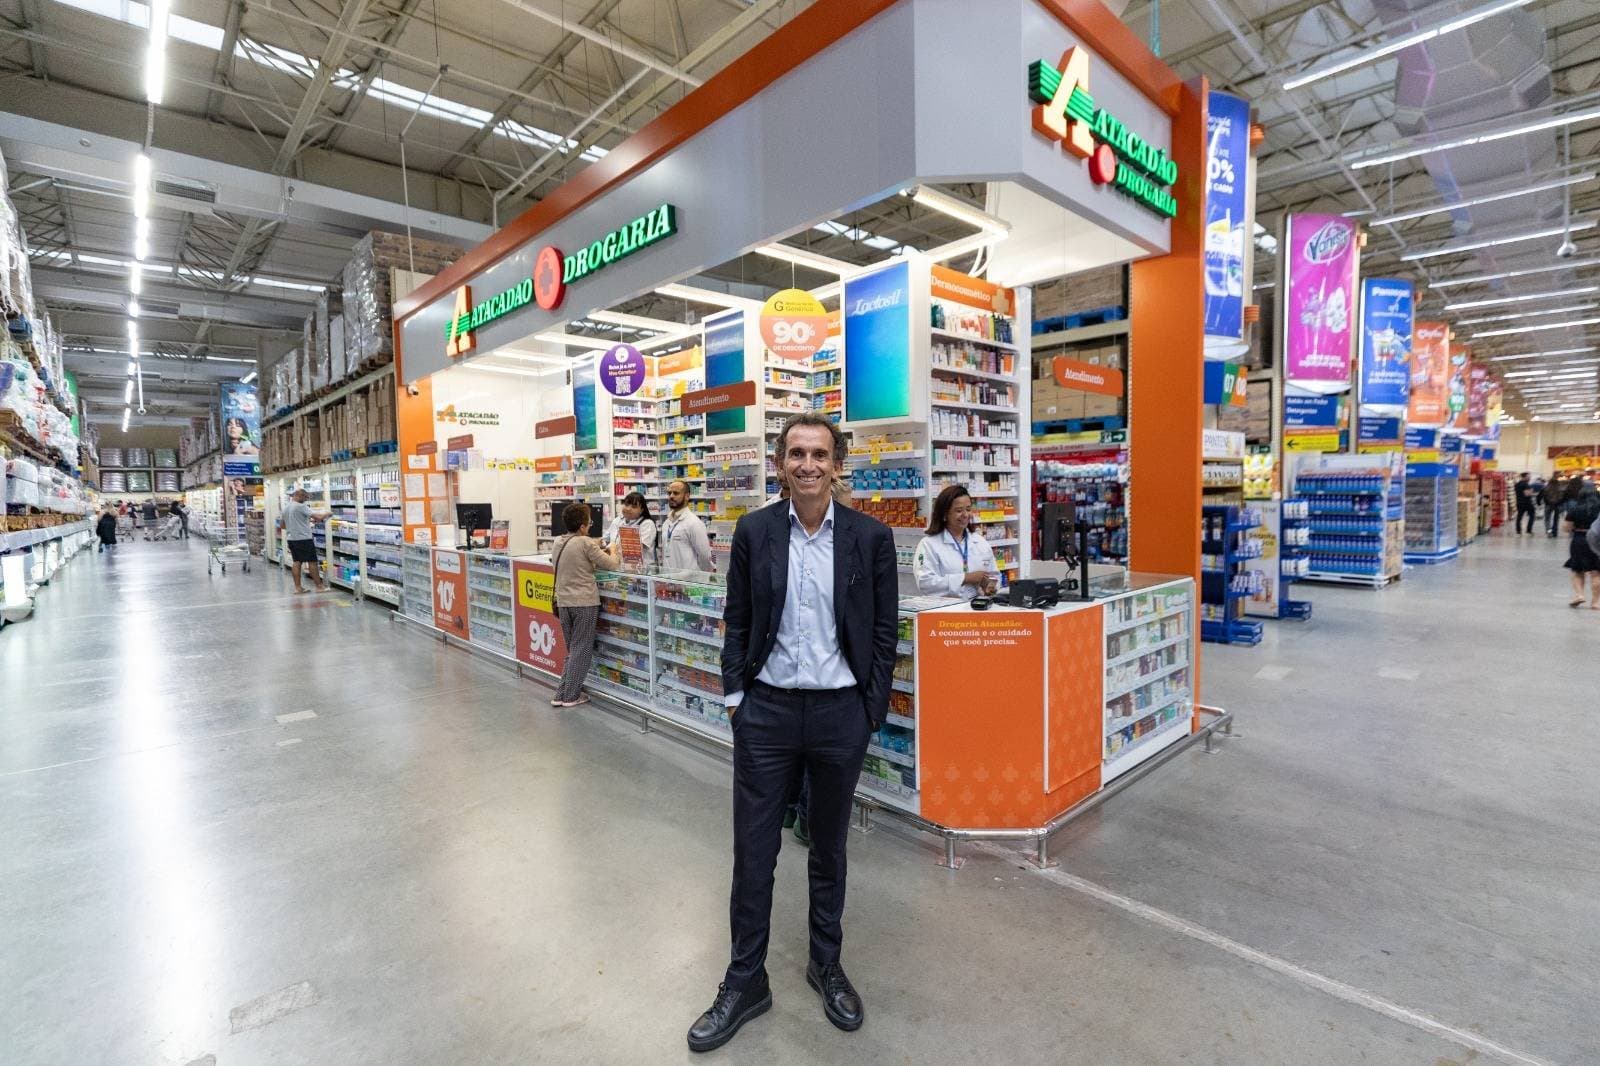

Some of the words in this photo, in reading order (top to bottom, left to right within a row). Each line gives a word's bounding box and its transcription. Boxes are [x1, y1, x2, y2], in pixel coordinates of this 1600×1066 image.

[1116, 162, 1177, 217] DROGARIA
[563, 204, 674, 284] DROGARIA
[772, 320, 816, 345] 90%
[1064, 368, 1105, 386] Atendimento
[688, 393, 729, 408] Atendimento
[525, 580, 533, 599] G
[938, 629, 980, 637] economia
[997, 629, 1032, 637] cuidado
[939, 620, 977, 630] Drogaria
[529, 620, 557, 656] 90%
[962, 638, 982, 646] você
